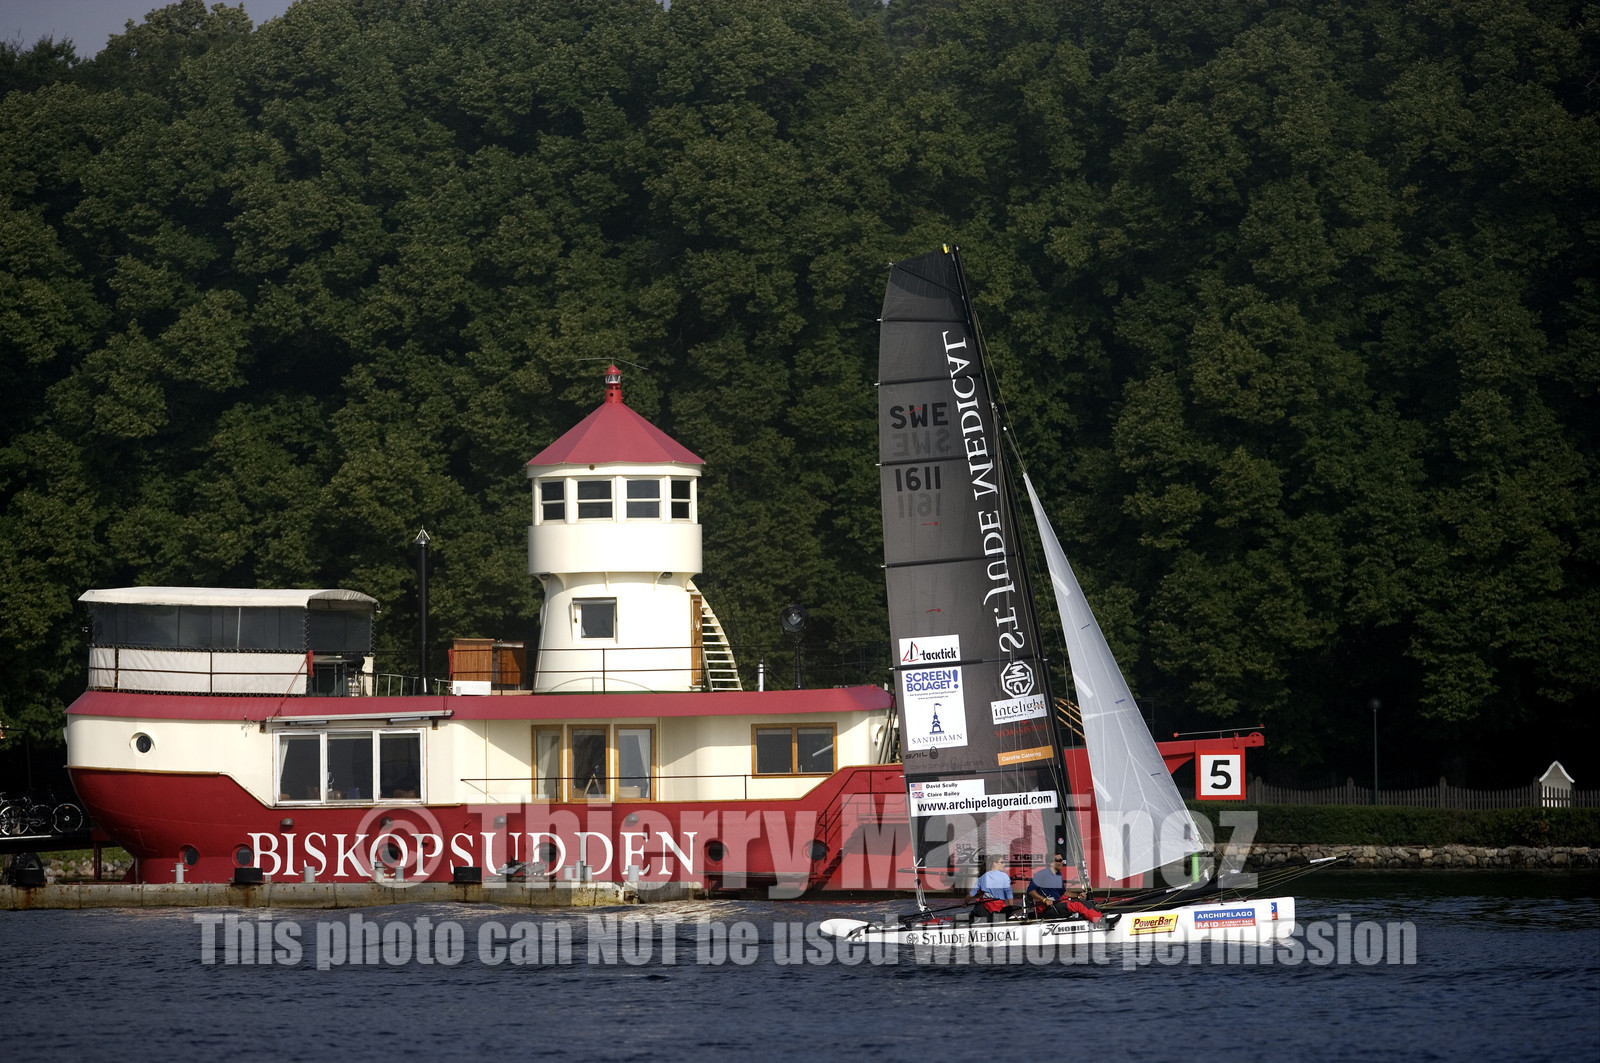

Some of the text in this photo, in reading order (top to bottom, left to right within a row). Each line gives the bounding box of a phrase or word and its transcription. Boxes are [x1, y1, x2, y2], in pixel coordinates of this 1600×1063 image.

[889, 402, 949, 430] SWE
[895, 466, 941, 492] 1611
[912, 733, 963, 745] SANDHAMN
[1210, 759, 1232, 790] 5
[917, 794, 1052, 812] www.archipelagoraid.com
[247, 831, 698, 877] BISKOPSUDDEN
[1134, 916, 1173, 928] PowerBar
[1197, 910, 1253, 919] ARCHIPELAGO
[1197, 921, 1219, 929] RAID
[968, 930, 1019, 943] MEDICAL
